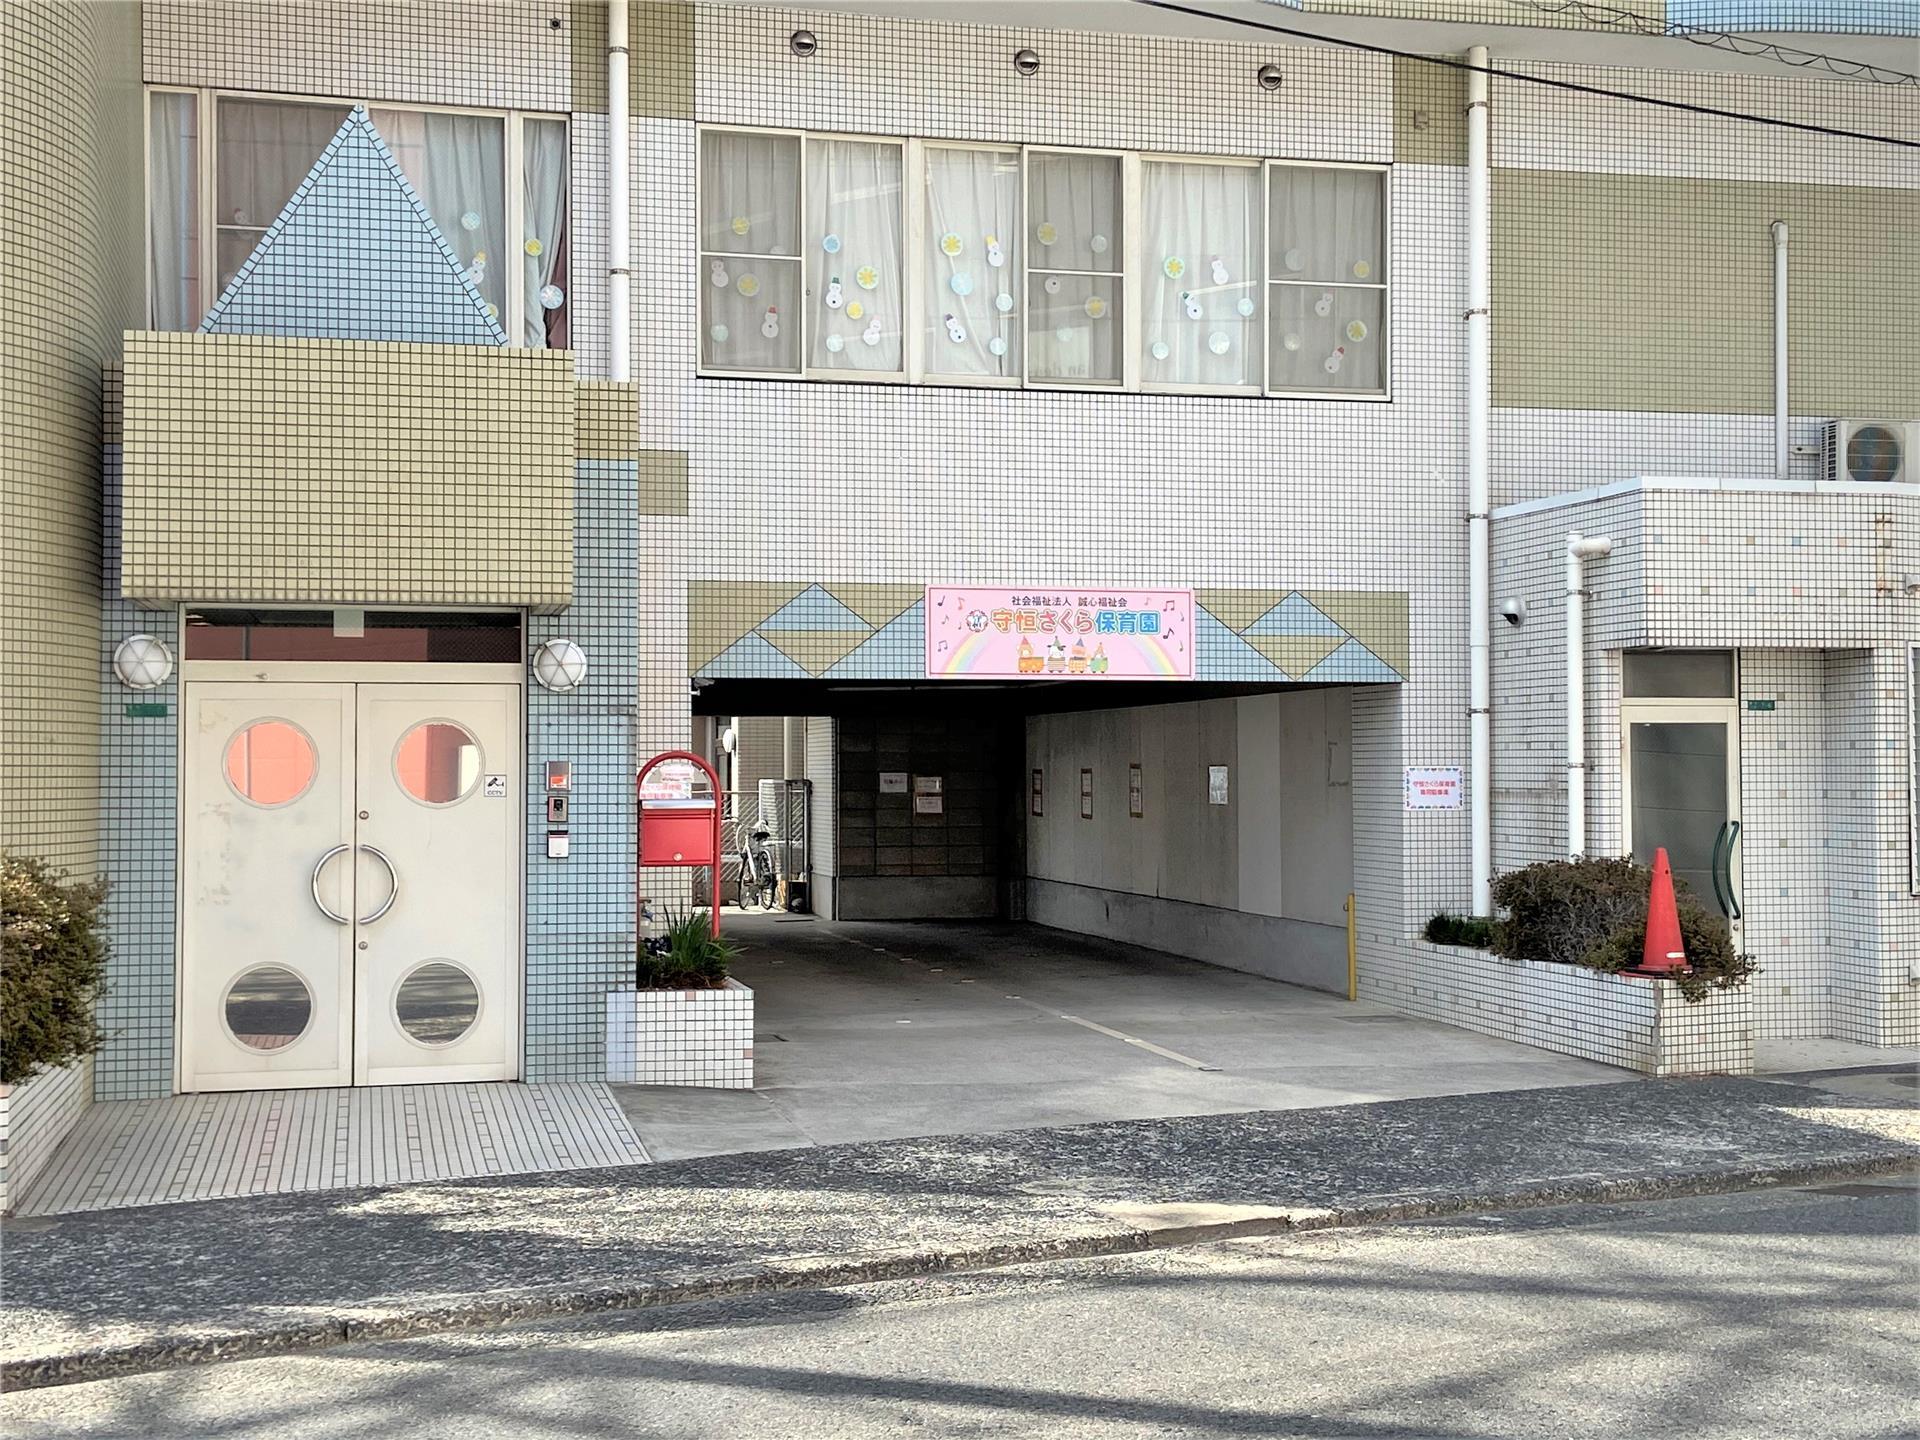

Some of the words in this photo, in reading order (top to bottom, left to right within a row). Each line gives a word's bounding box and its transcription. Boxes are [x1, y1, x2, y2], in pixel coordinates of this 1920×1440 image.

[1011, 595, 1072, 607] 社会福祉法人
[1077, 596, 1128, 608] 誠心福祉会
[991, 609, 1160, 634] 守恒さくら保育園
